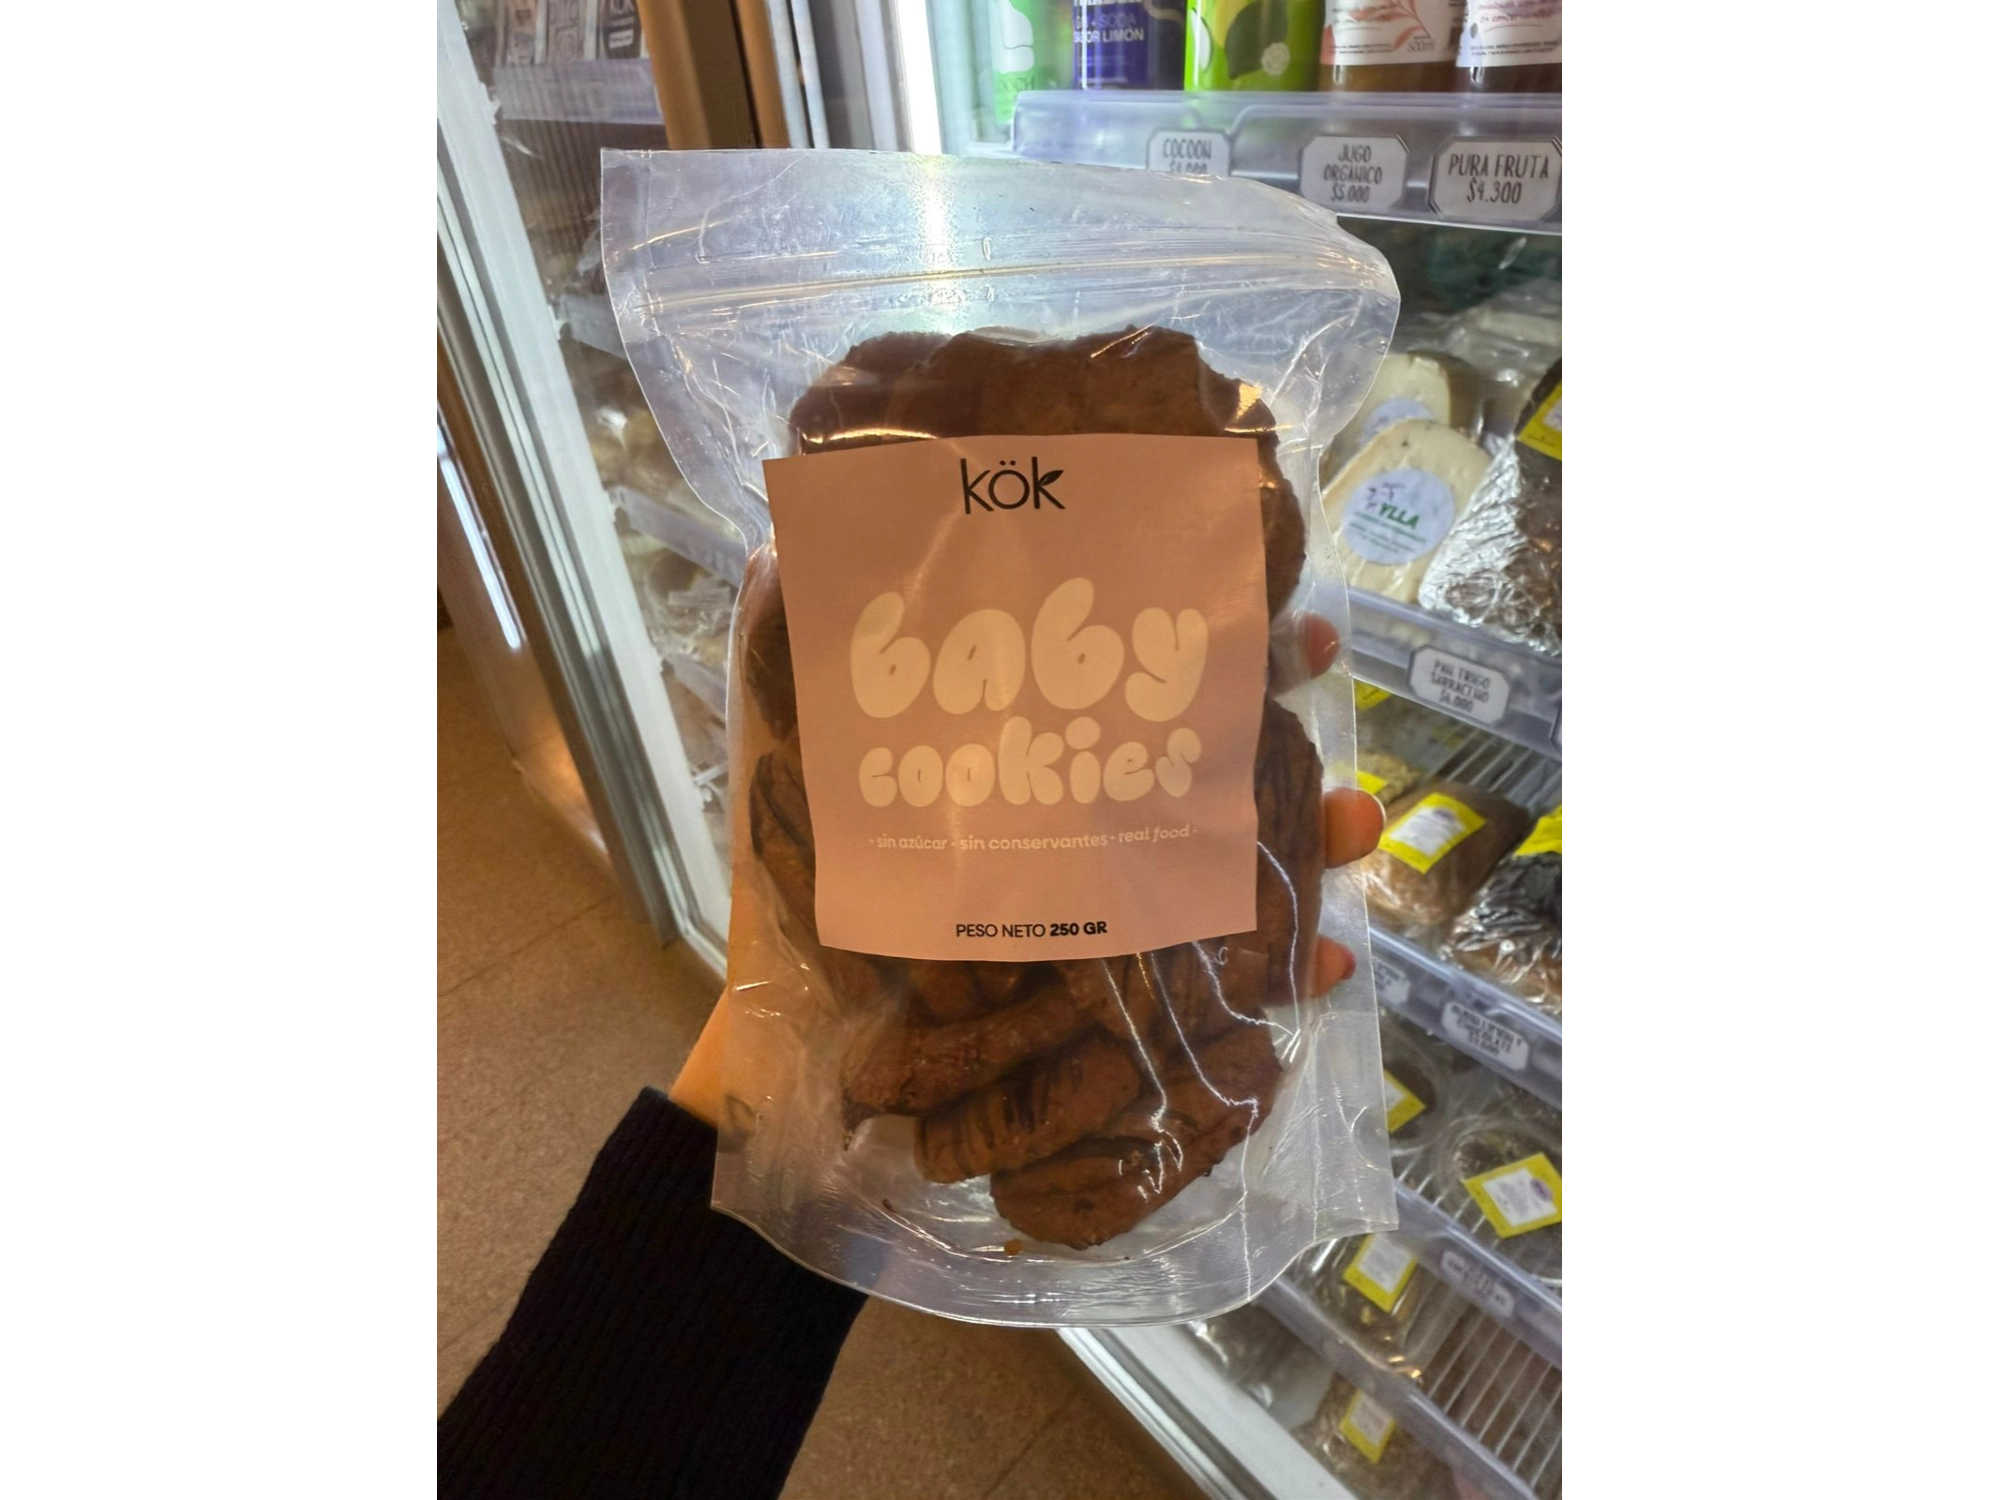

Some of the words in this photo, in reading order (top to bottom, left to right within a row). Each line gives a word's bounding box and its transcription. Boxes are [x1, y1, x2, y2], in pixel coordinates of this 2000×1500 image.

[1162, 138, 1213, 160] COCOON
[1337, 143, 1372, 163] JUGO
[1447, 153, 1490, 178] PURA
[1493, 155, 1550, 180] FRUTA
[1466, 178, 1523, 205] $4.300
[959, 456, 1066, 515] kök
[858, 715, 1202, 808] cookies
[876, 833, 897, 849] sin
[899, 834, 948, 851] azúcar
[959, 834, 985, 850] sin
[988, 833, 1109, 851] conservantes
[1117, 827, 1150, 844] real
[1151, 823, 1190, 844] food
[955, 924, 998, 938] PESO
[1002, 924, 1046, 938] NETO
[1049, 922, 1079, 937] 250
[1083, 920, 1108, 935] GR
